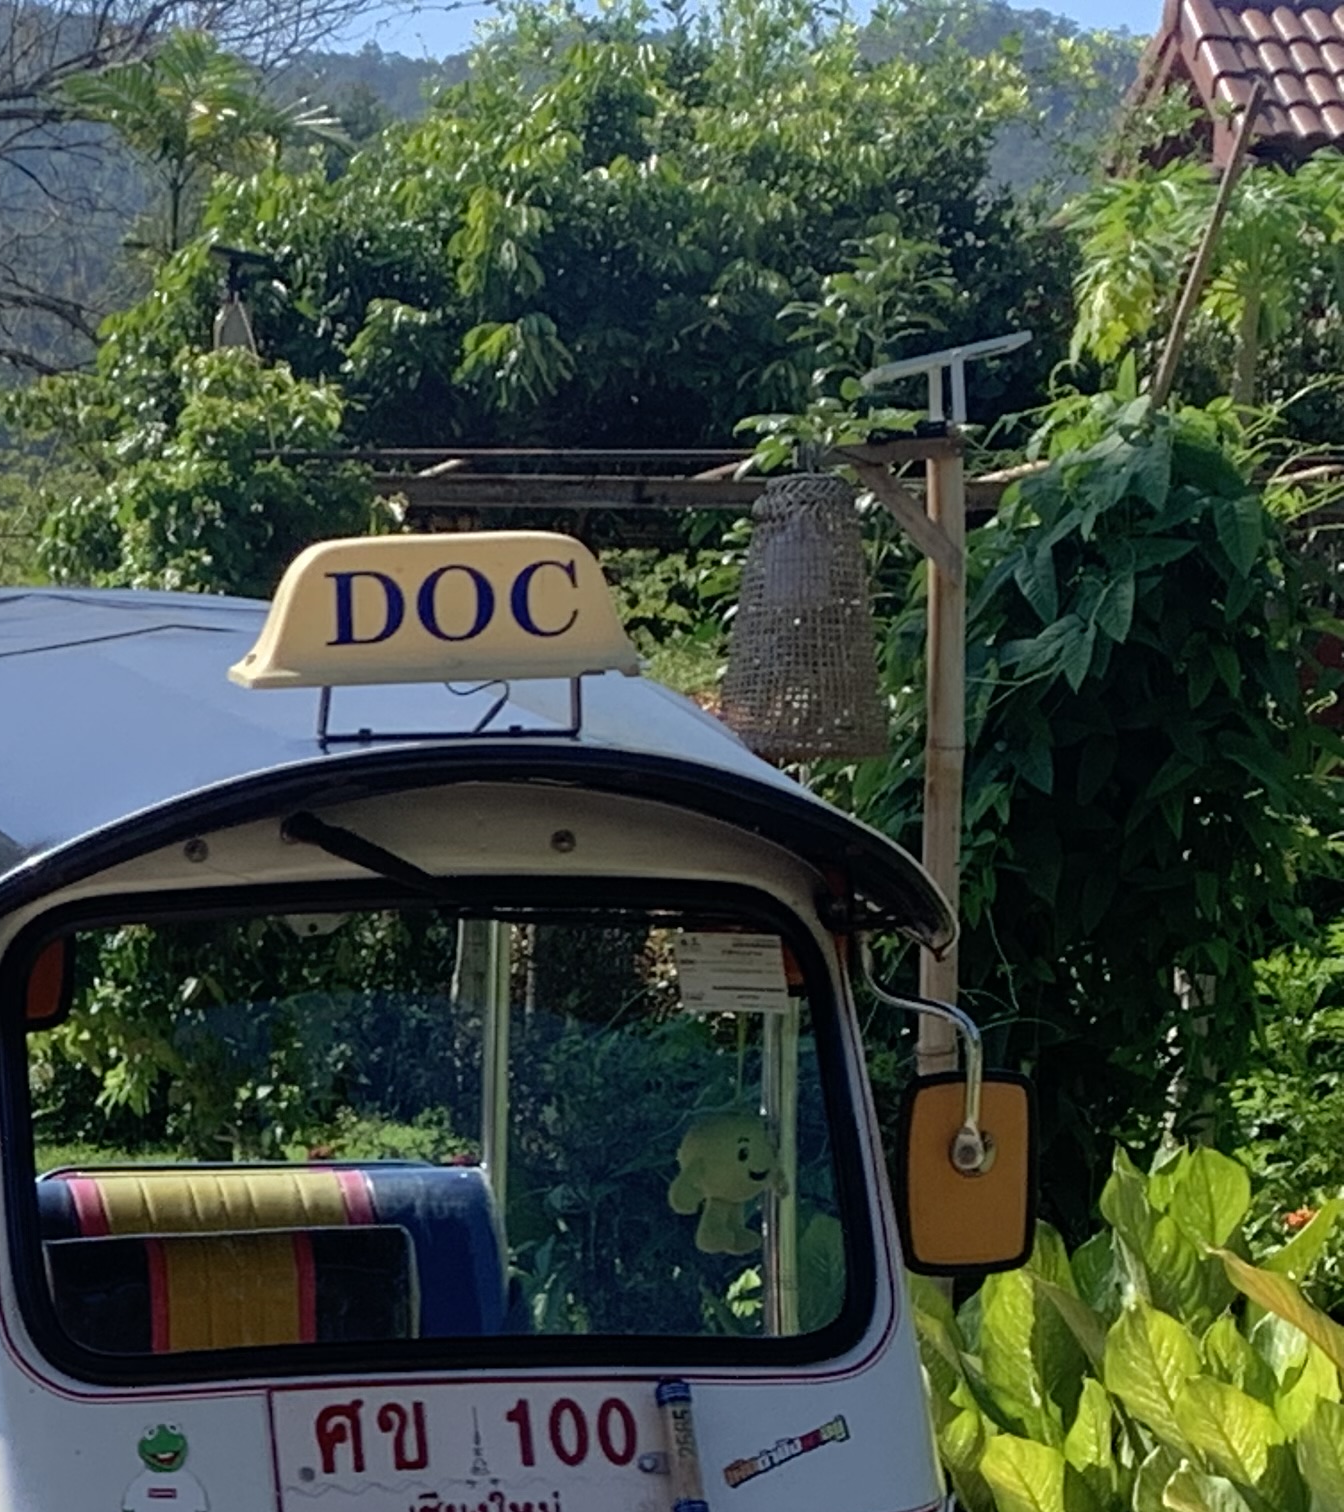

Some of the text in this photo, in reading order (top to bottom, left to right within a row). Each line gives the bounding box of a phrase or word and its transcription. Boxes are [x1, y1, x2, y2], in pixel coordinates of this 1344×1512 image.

[324, 558, 580, 646] DOC
[315, 1398, 430, 1474] ศข
[506, 1397, 638, 1467] 100
